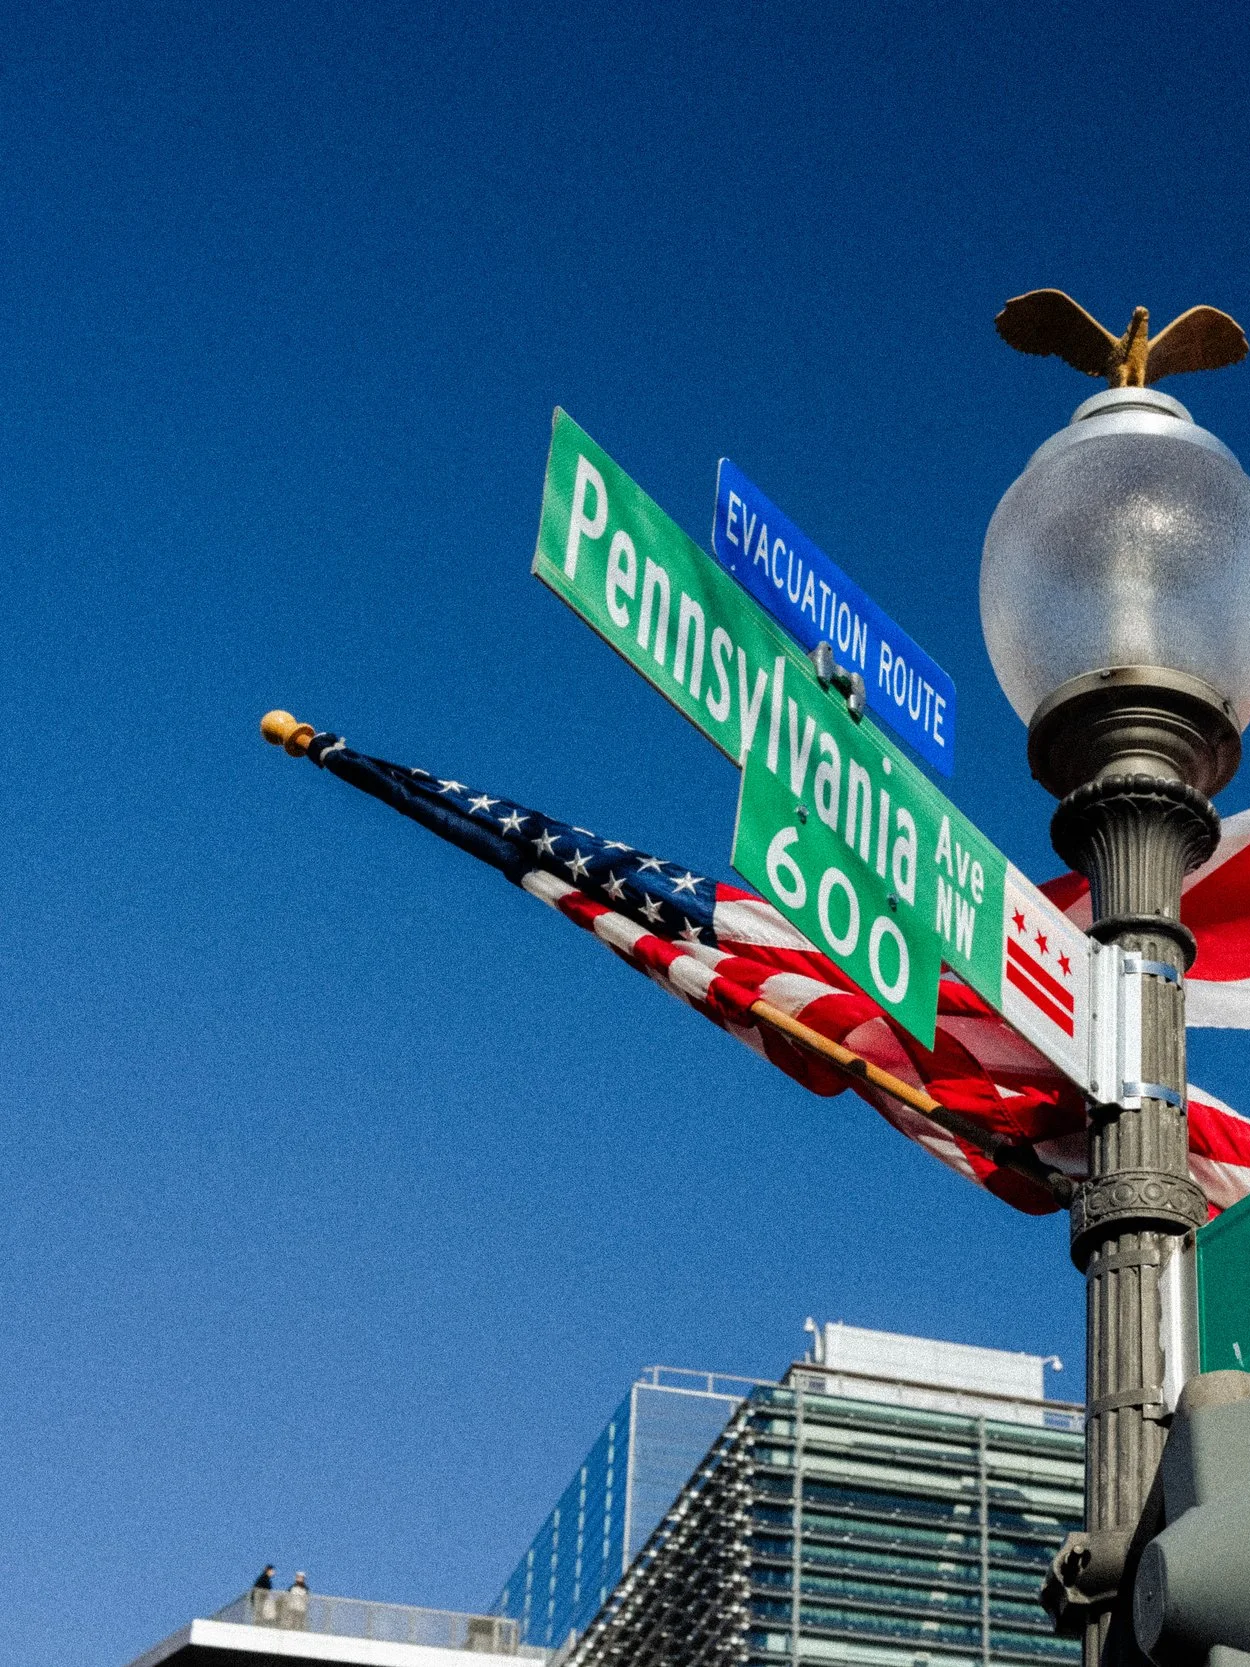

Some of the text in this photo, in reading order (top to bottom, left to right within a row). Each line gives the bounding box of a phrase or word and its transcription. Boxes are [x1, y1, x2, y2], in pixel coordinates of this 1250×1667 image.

[563, 454, 918, 906] Pennsylvania
[725, 489, 946, 748] EVACUATION ROUTE
[766, 826, 910, 1004] 600
[935, 814, 985, 905] Ave
[935, 875, 976, 961] NW
